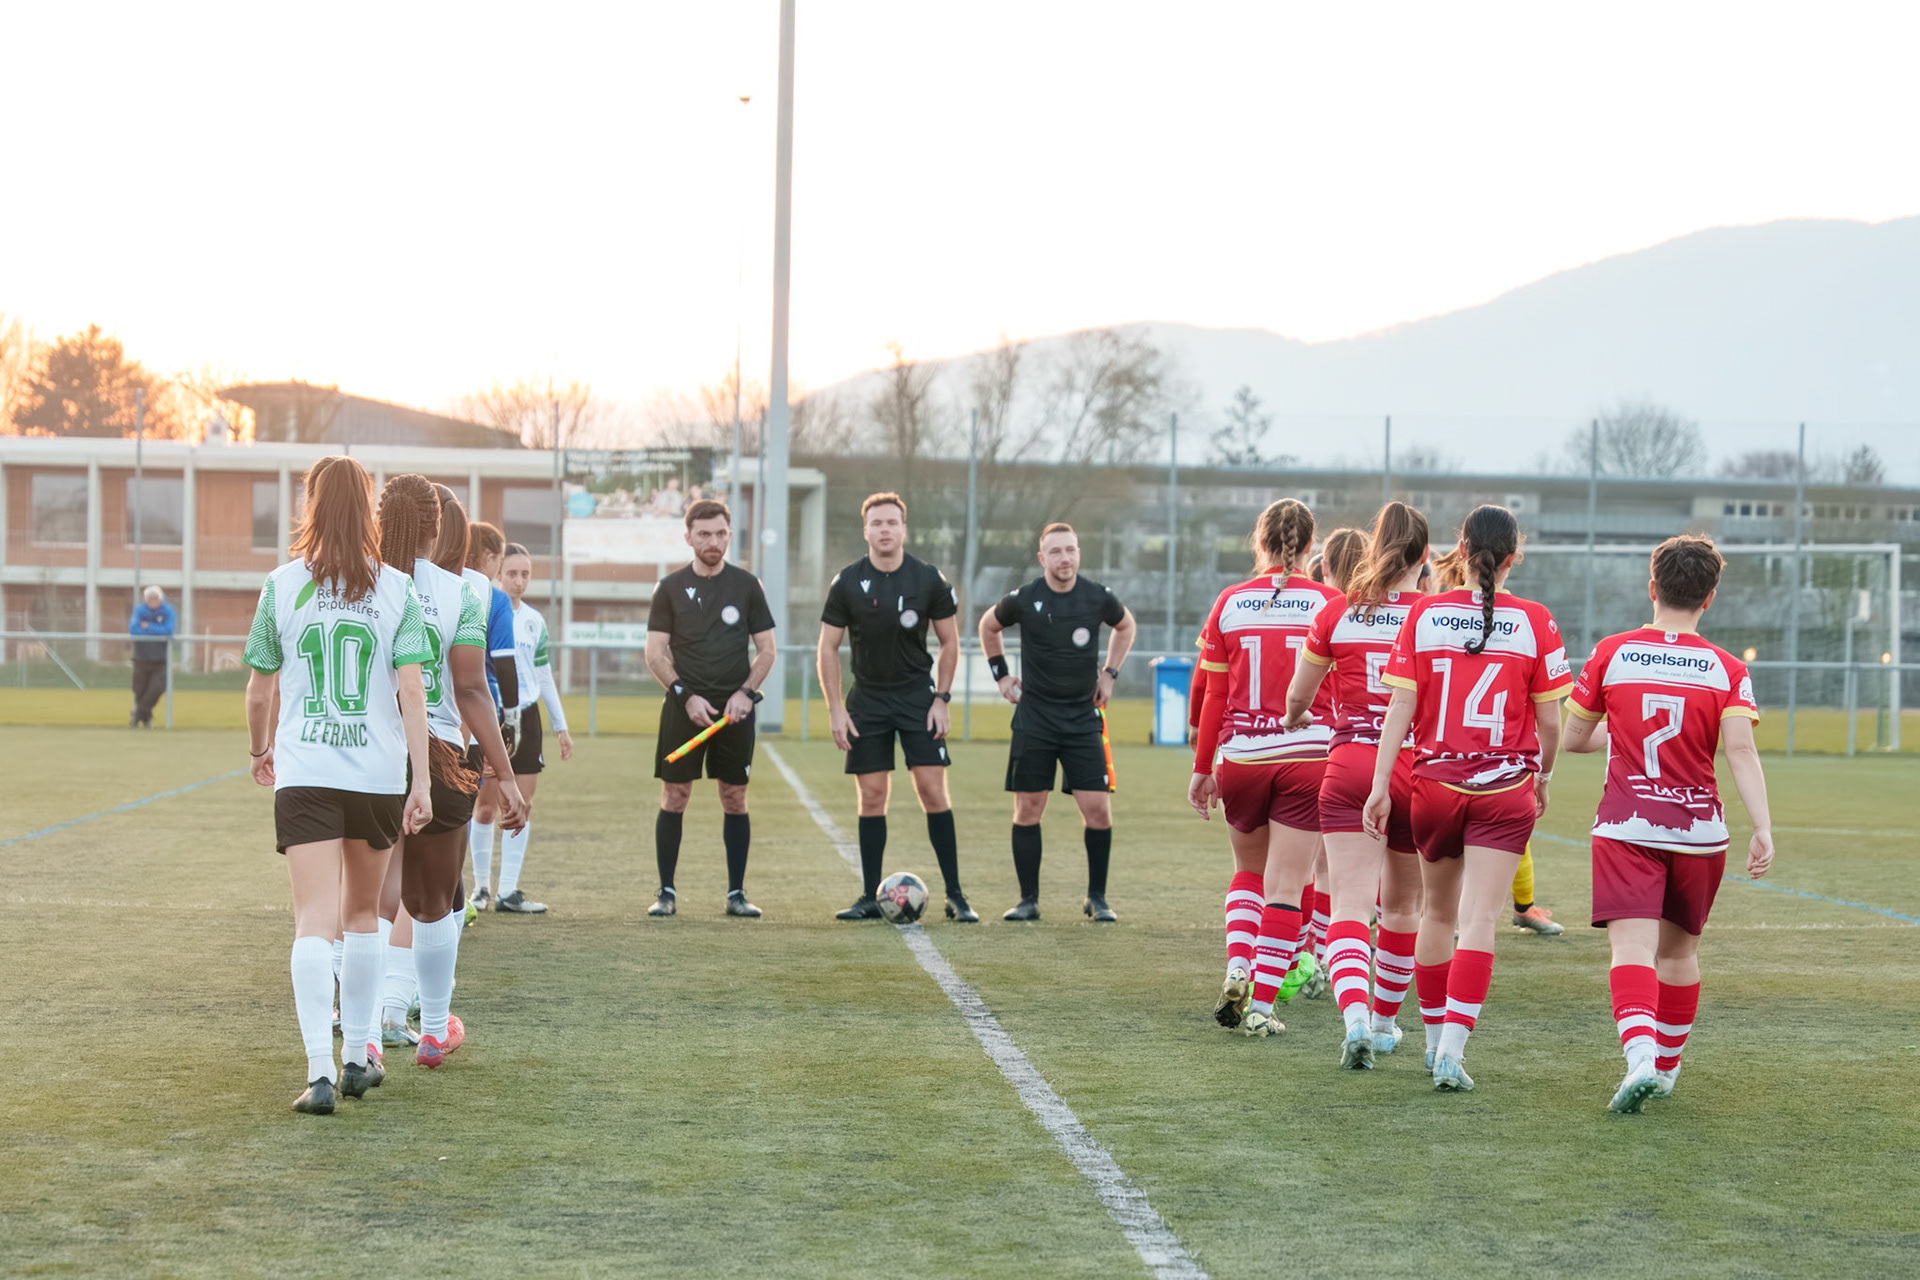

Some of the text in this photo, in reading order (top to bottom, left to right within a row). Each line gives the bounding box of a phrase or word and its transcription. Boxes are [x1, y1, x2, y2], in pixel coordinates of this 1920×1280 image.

[1432, 616, 1513, 635] vogelsng
[297, 619, 377, 717] 10
[1621, 652, 1709, 672] vogelsang
[1432, 658, 1507, 746] 14
[301, 721, 368, 747] LE FRANC
